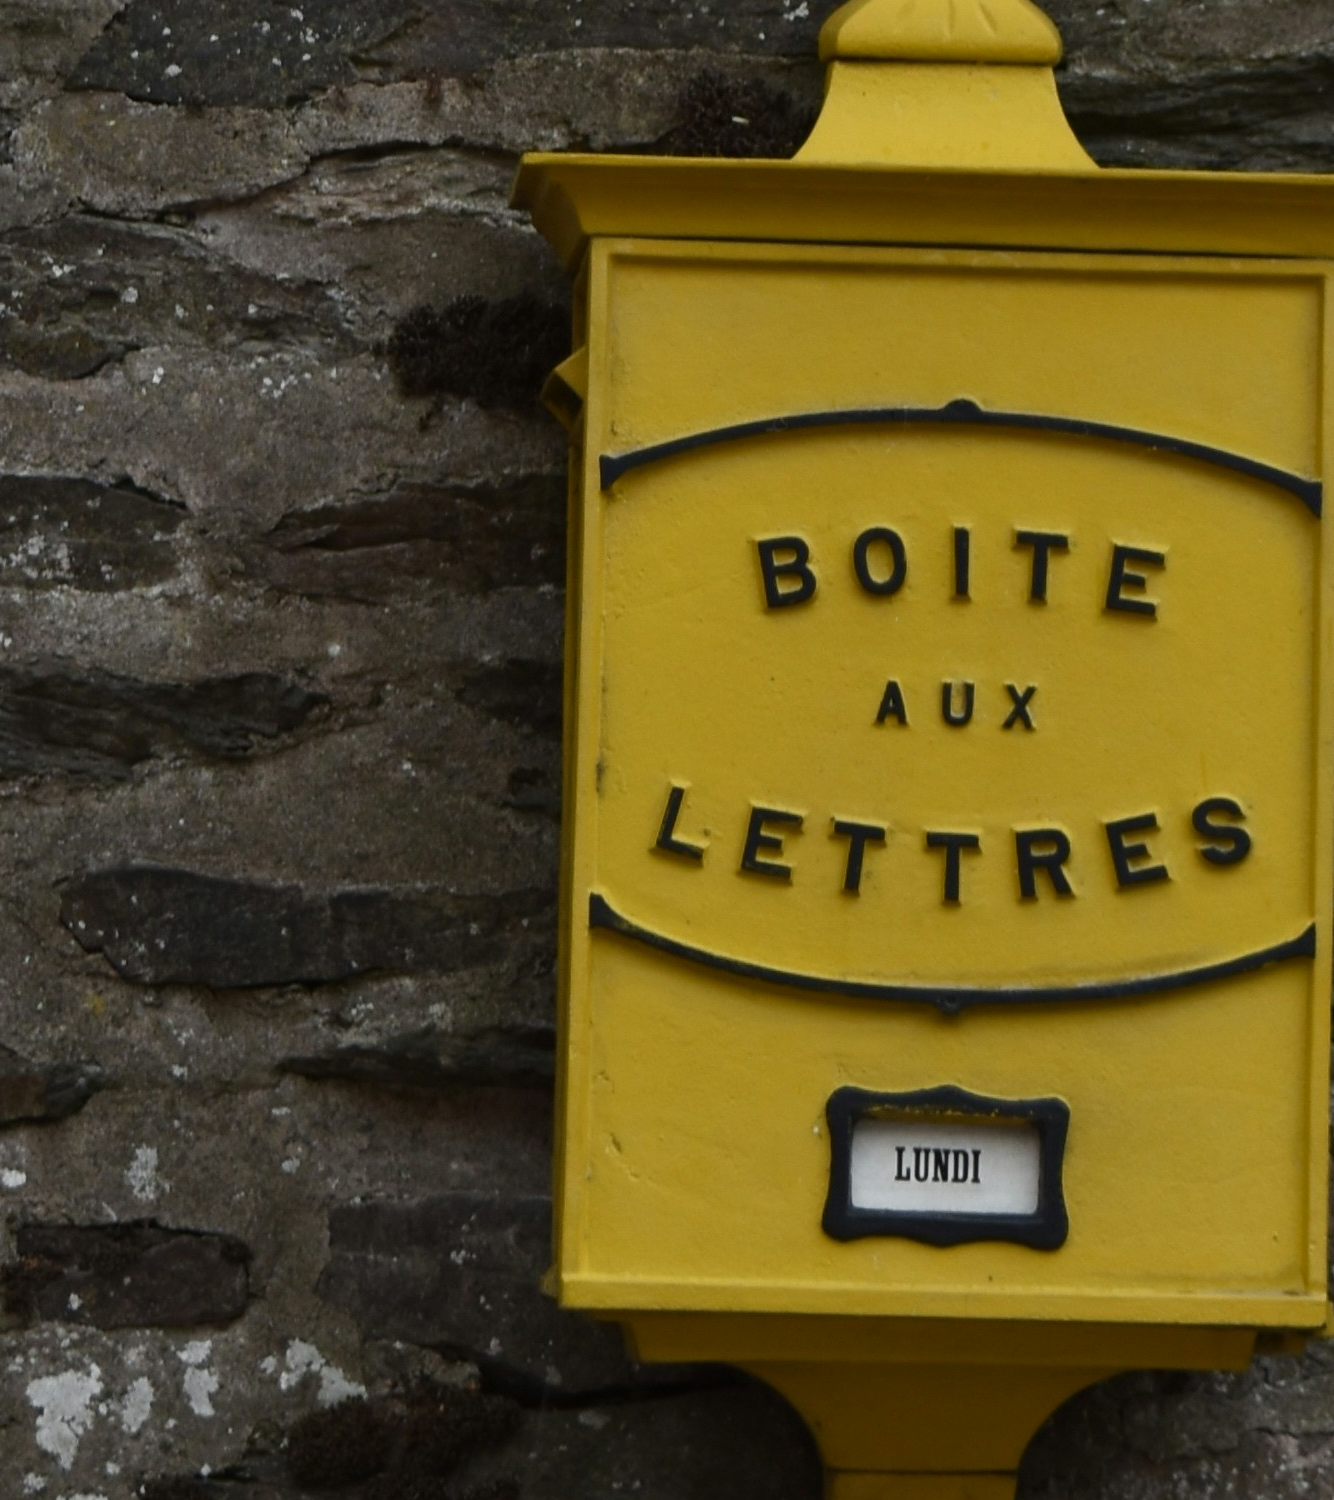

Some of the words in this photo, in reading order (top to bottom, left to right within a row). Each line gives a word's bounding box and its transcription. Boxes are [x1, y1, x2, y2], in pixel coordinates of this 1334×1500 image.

[755, 527, 1166, 616] BOITE
[875, 680, 1038, 730] AUX
[655, 786, 1253, 904] LETTRES
[895, 1146, 981, 1184] LUNDI
